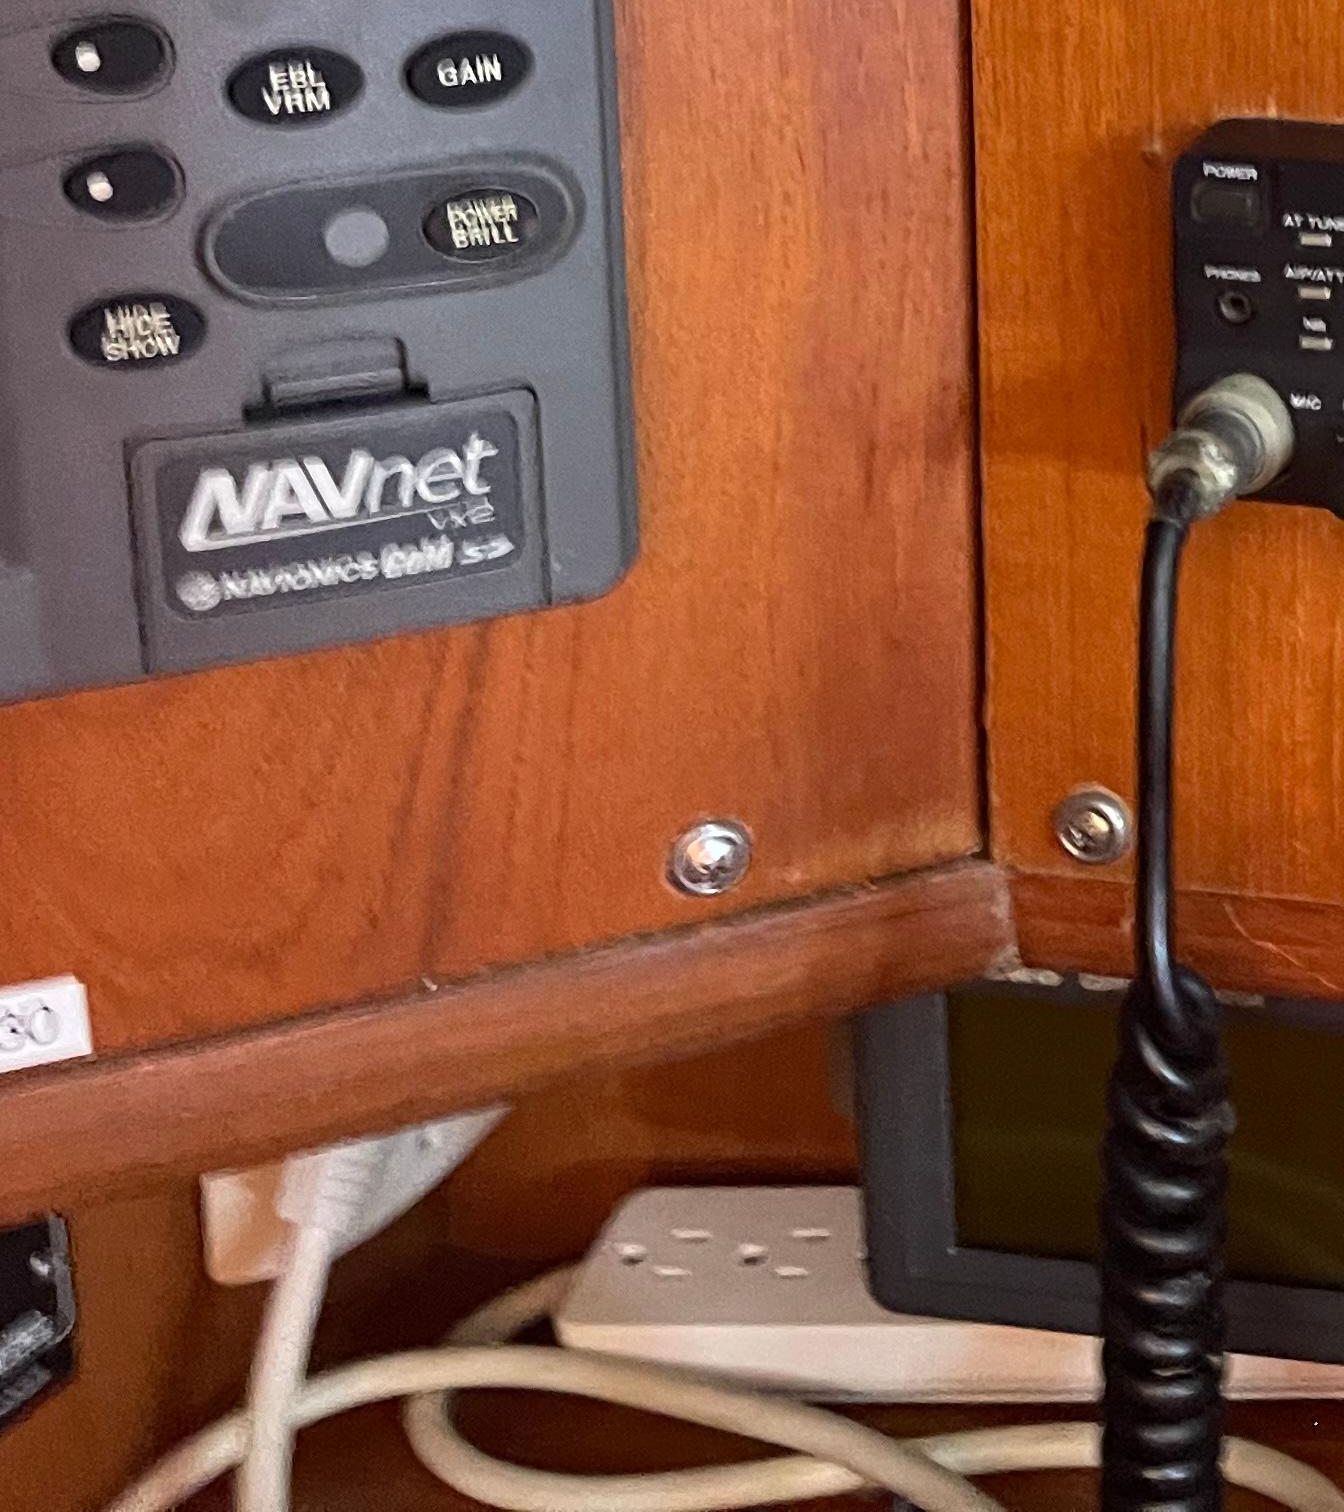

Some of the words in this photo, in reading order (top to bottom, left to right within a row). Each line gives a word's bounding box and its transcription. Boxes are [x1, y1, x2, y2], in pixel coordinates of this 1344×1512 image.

[268, 61, 326, 91] EBL
[436, 54, 502, 88] GAIN
[261, 88, 331, 115] VRM
[450, 221, 520, 250] BRILL
[102, 332, 182, 362] SHOW
[178, 431, 499, 552] NAVnet
